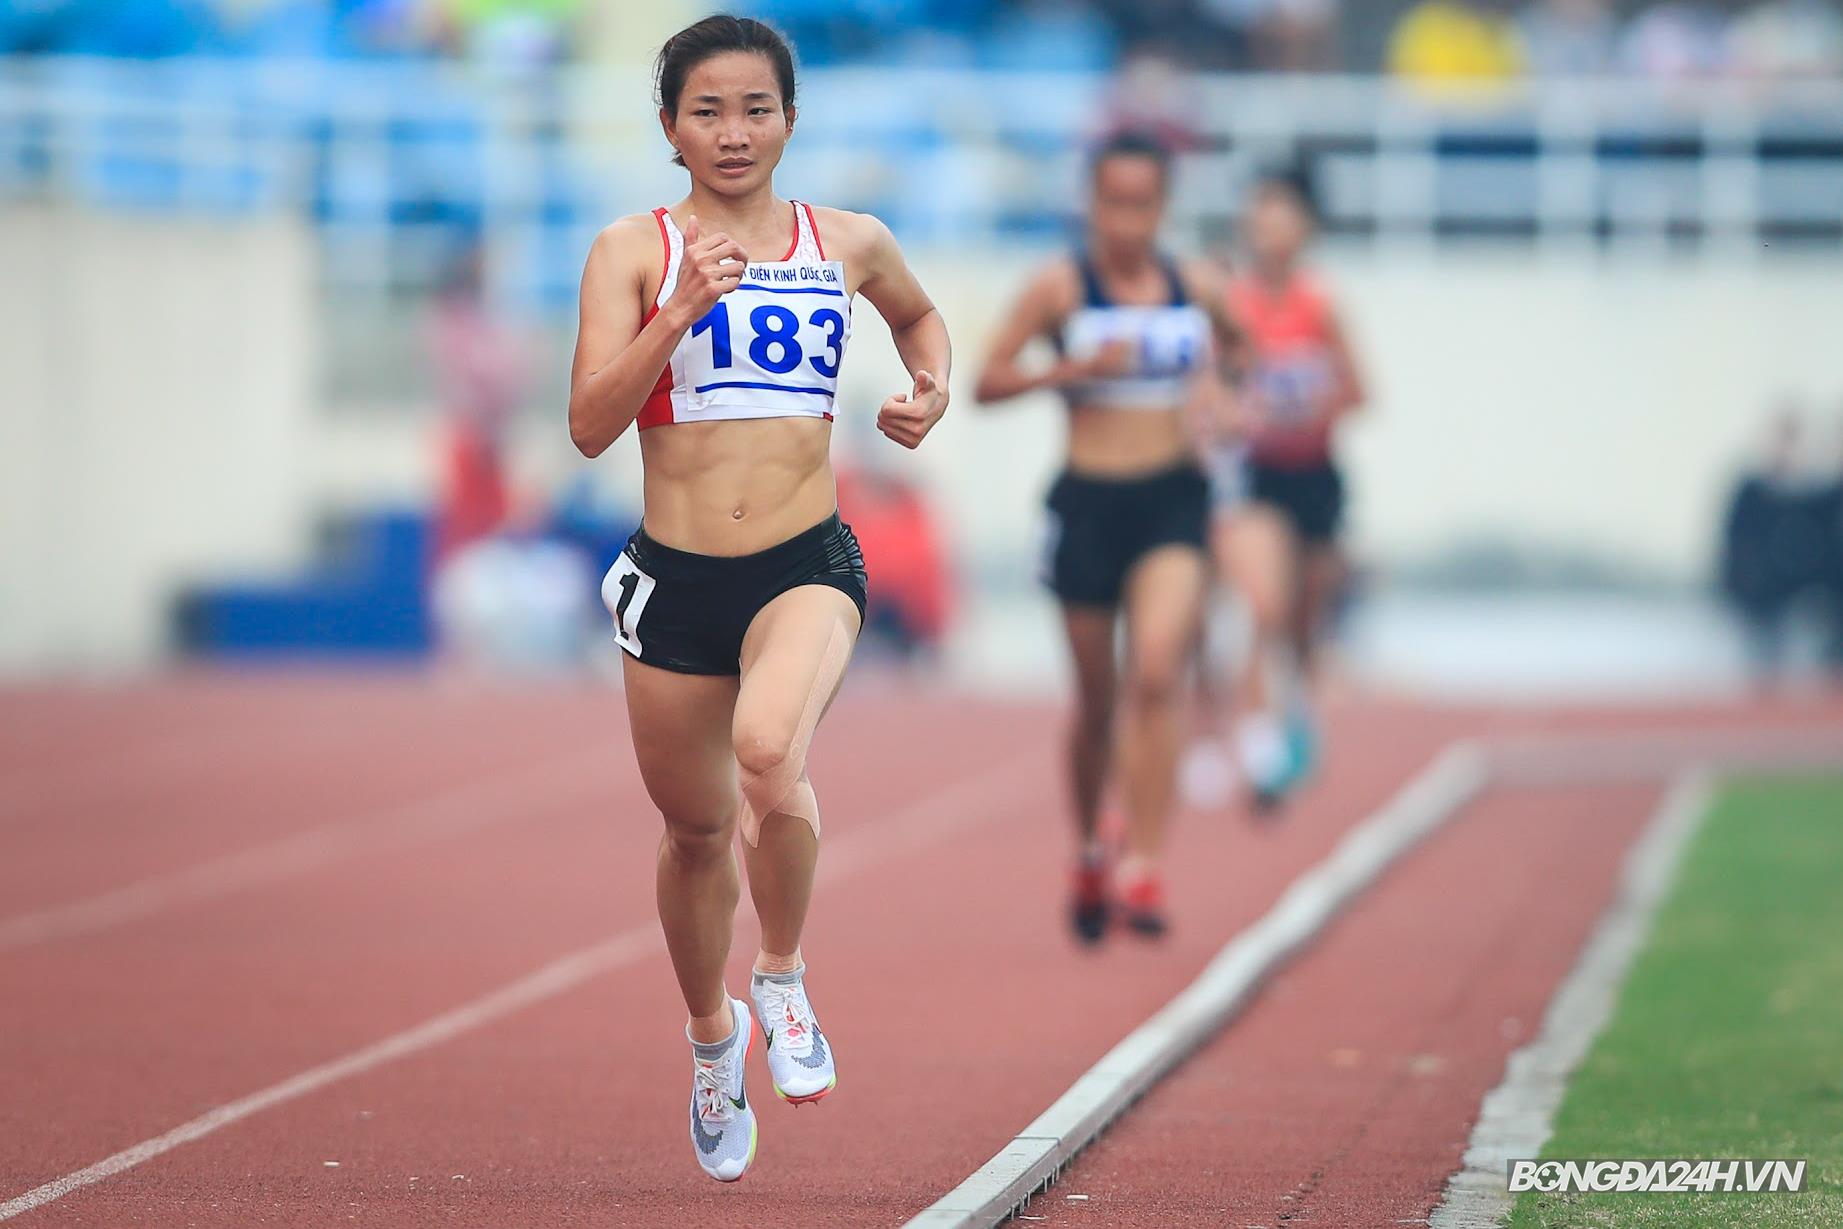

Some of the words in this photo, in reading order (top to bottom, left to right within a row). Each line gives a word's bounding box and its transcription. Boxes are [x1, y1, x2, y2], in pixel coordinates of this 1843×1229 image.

[773, 268, 797, 283] KINH
[823, 269, 838, 283] GIA
[692, 302, 844, 378] 183
[616, 571, 640, 641] 1
